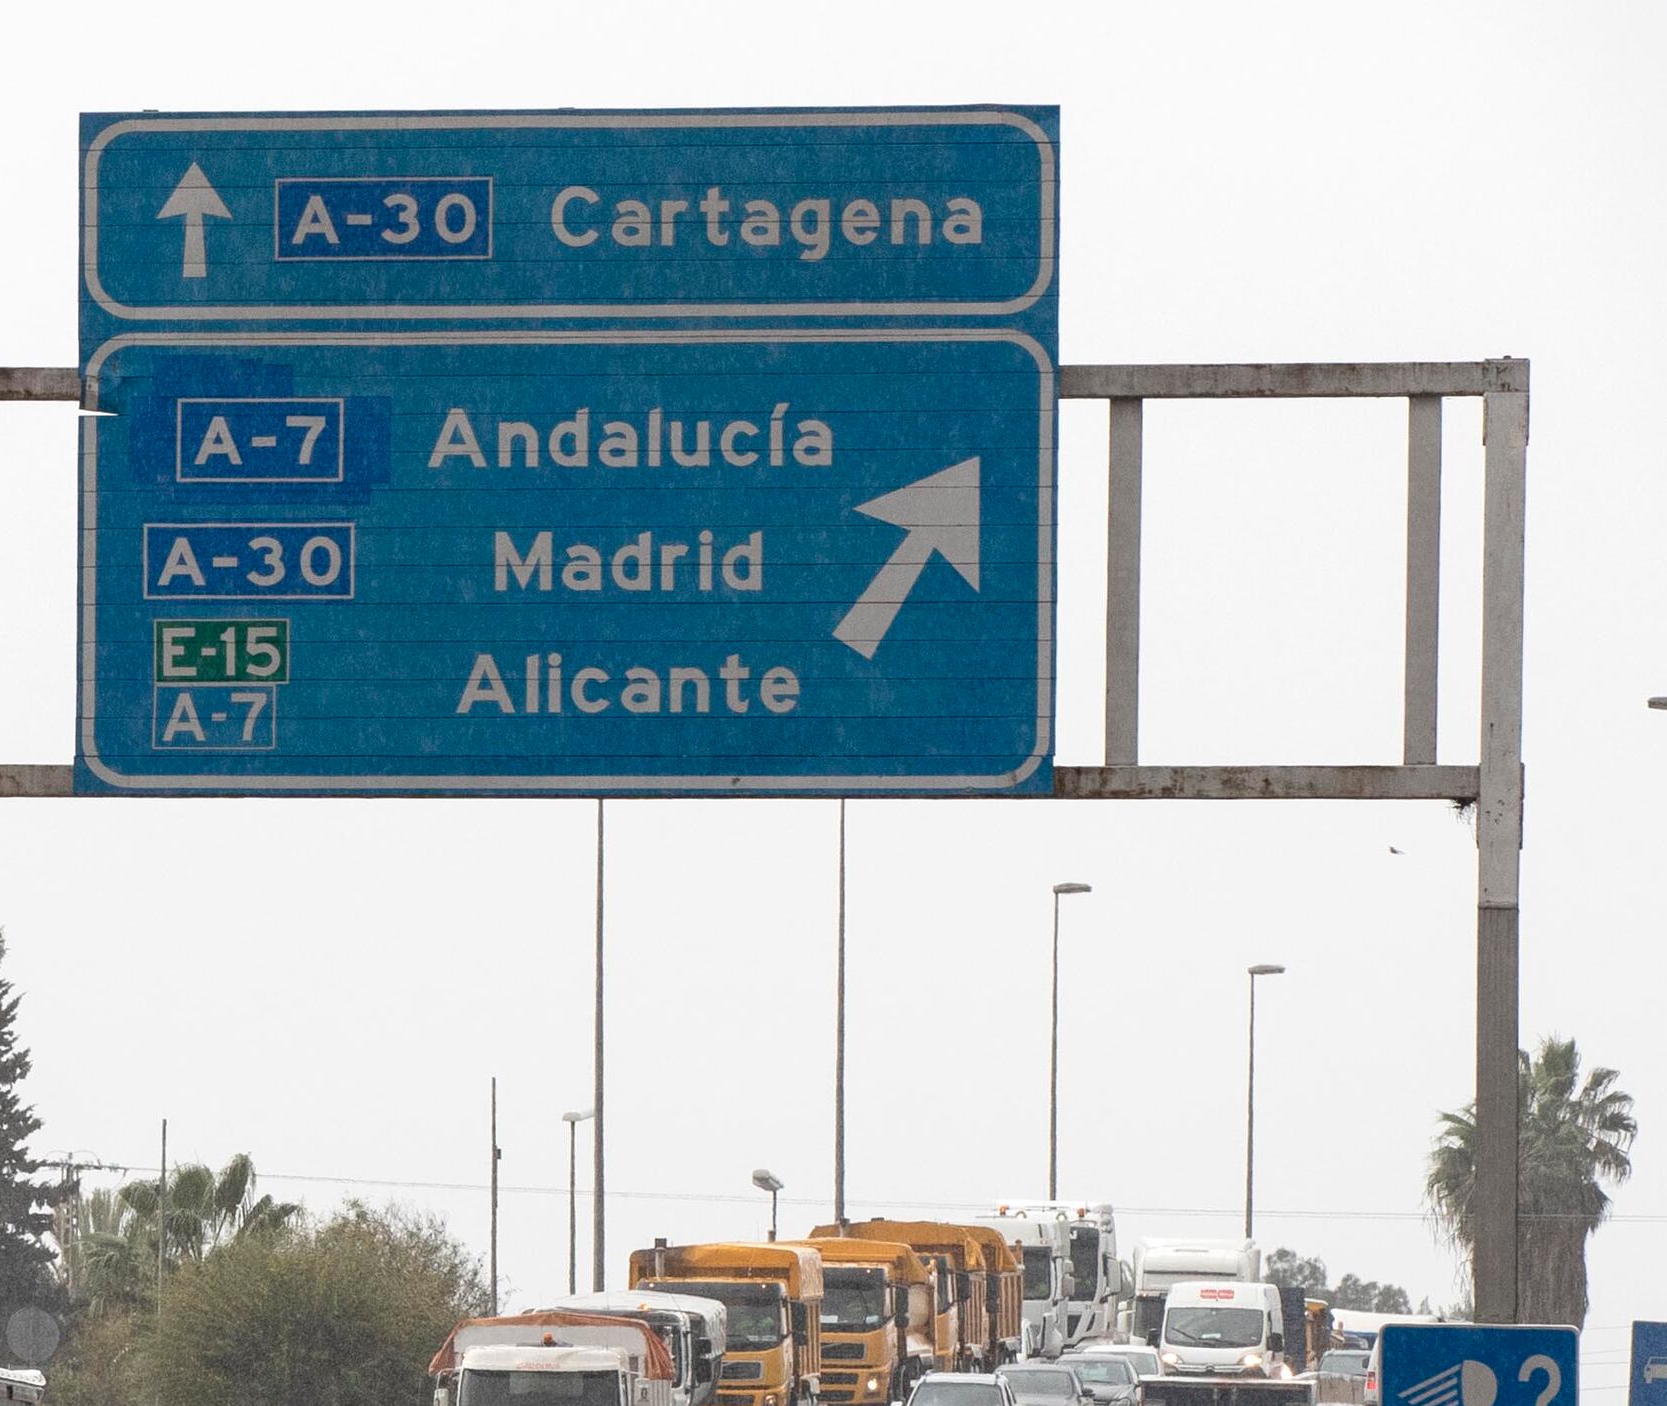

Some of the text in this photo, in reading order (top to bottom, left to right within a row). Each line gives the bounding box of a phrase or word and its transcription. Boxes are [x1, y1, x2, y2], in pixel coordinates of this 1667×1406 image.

[290, 184, 984, 261] A-30 Cartagena
[193, 402, 834, 468] A-7 Andalucía
[156, 530, 764, 592] A-30 Madrid
[160, 628, 281, 679] E-15
[456, 652, 801, 716] Alicante
[162, 692, 267, 742] A-7
